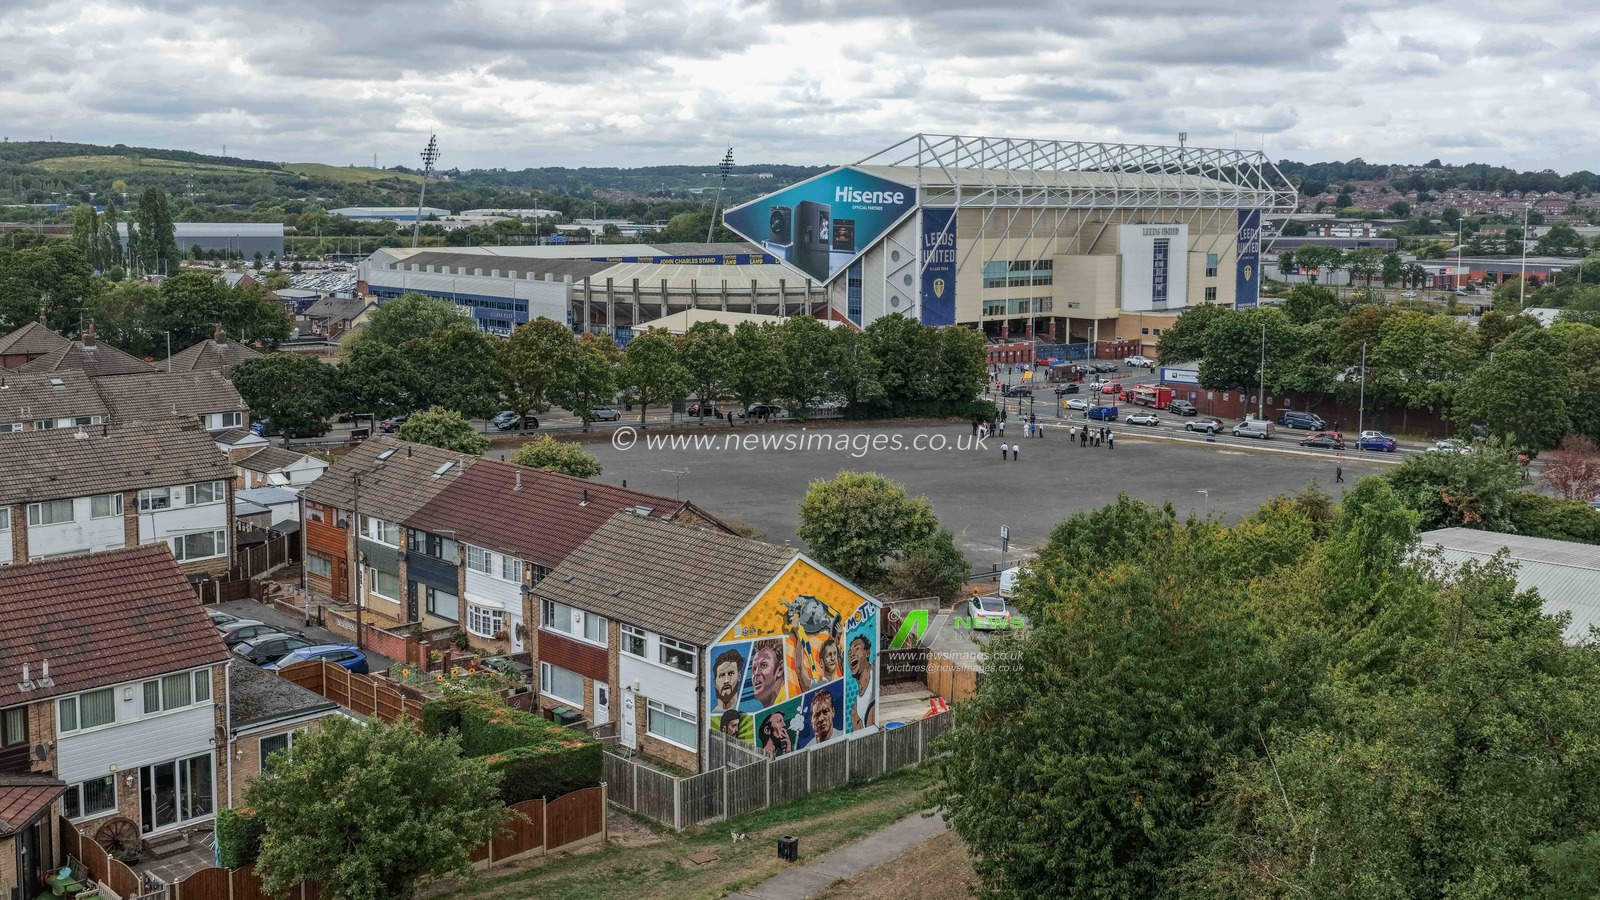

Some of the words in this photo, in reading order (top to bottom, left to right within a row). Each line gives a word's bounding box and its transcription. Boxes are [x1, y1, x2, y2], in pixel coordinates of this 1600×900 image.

[835, 186, 904, 204] Hisense
[1142, 227, 1160, 236] LEEDS
[1161, 227, 1180, 236] UNITED
[1240, 228, 1258, 240] LEEDS
[925, 232, 954, 247] LEEDS
[923, 249, 955, 263] UNITED
